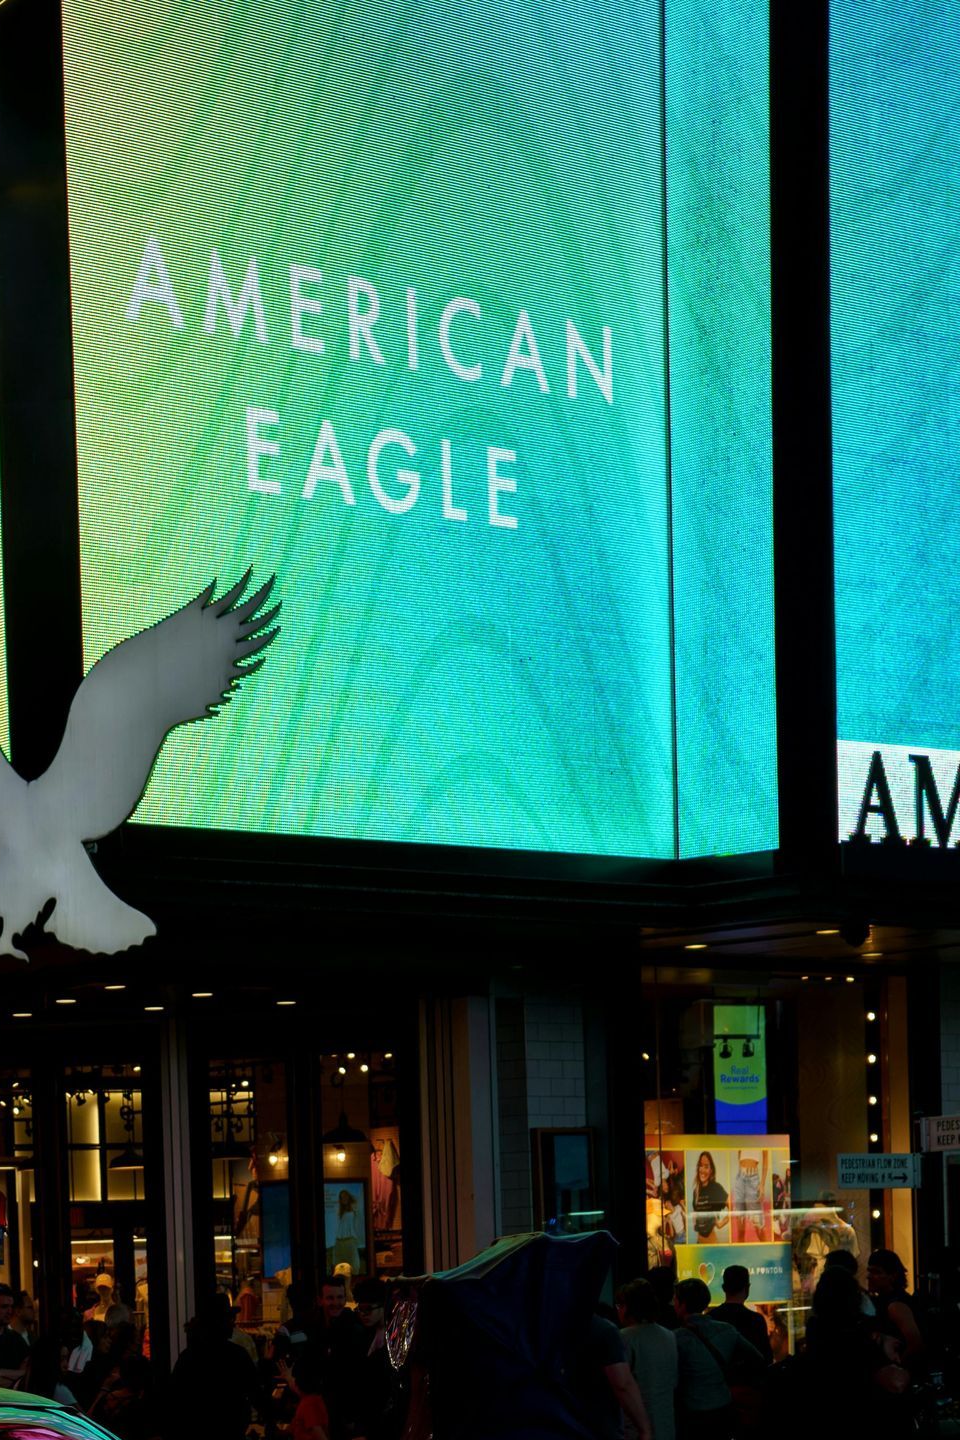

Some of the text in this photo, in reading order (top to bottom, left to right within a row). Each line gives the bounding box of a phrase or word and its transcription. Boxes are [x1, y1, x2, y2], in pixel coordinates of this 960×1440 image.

[124, 236, 615, 405] AMERICAN
[245, 406, 519, 529] EAGLE
[720, 1074, 760, 1083] Rewards
[937, 1135, 955, 1146] KEEP
[840, 1157, 908, 1169] PEDESTRIAN FLOW ZONE
[841, 1173, 879, 1184] KEEP MOVING
